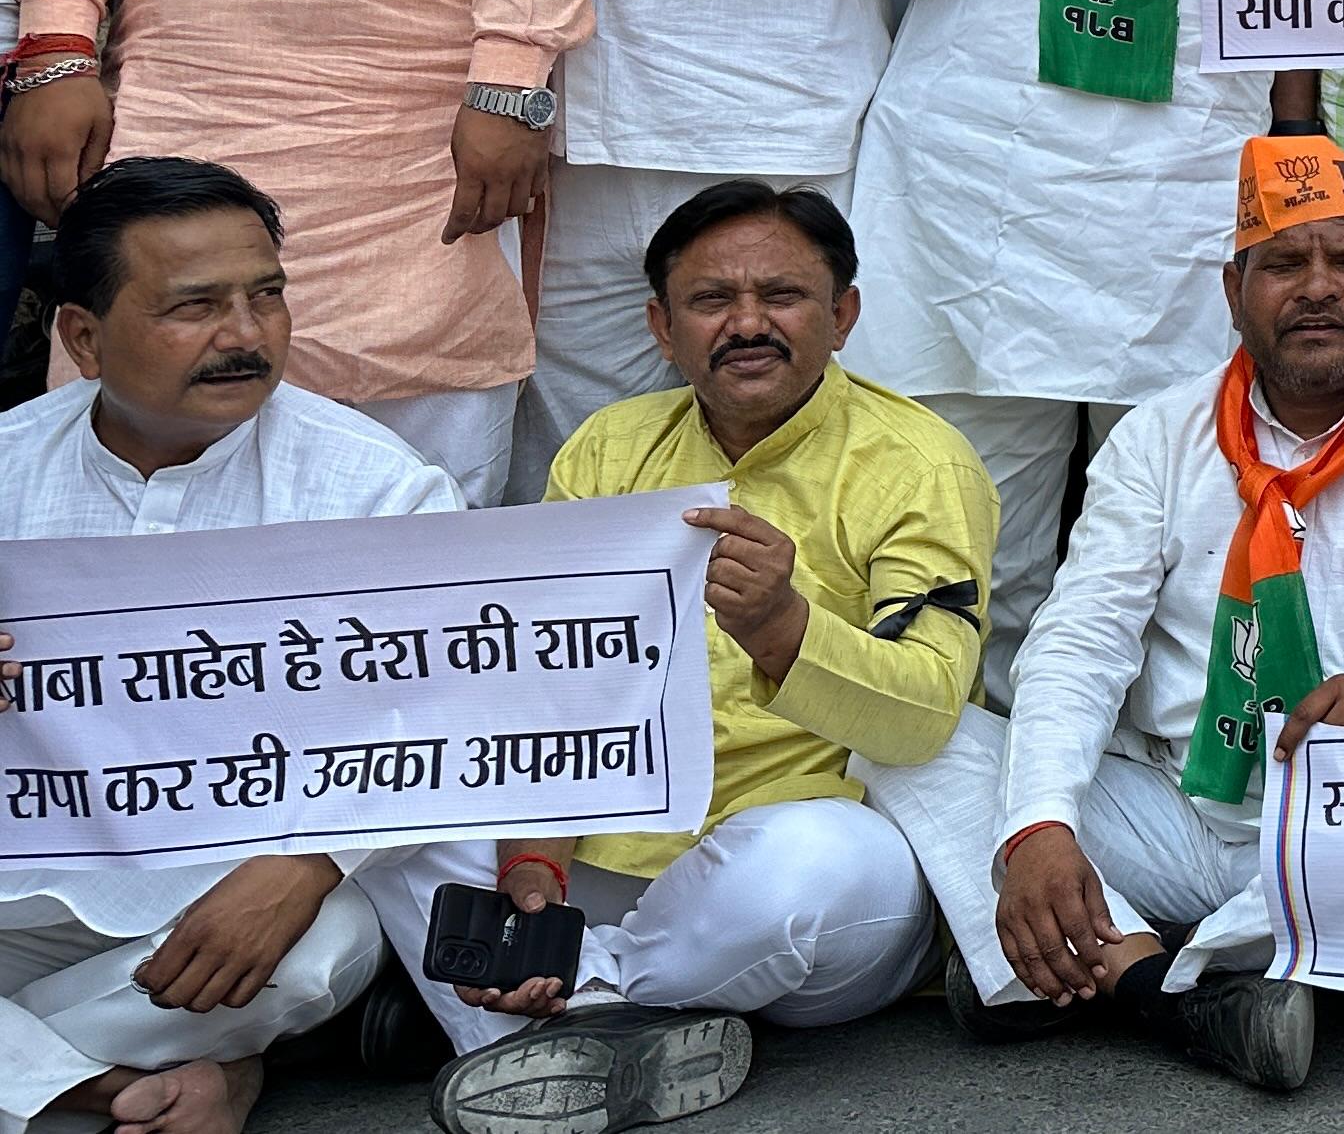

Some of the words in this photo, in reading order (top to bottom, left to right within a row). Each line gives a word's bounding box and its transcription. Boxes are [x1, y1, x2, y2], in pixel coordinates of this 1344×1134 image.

[118, 629, 266, 703] साहेब
[279, 619, 323, 691] है
[336, 617, 429, 683] देश
[443, 603, 518, 674] की
[532, 615, 660, 671] शान,
[5, 769, 91, 818] सपा
[103, 759, 197, 816] कर
[206, 732, 290, 807] रही
[303, 738, 448, 798] उनका
[460, 718, 655, 788] अपमान।
